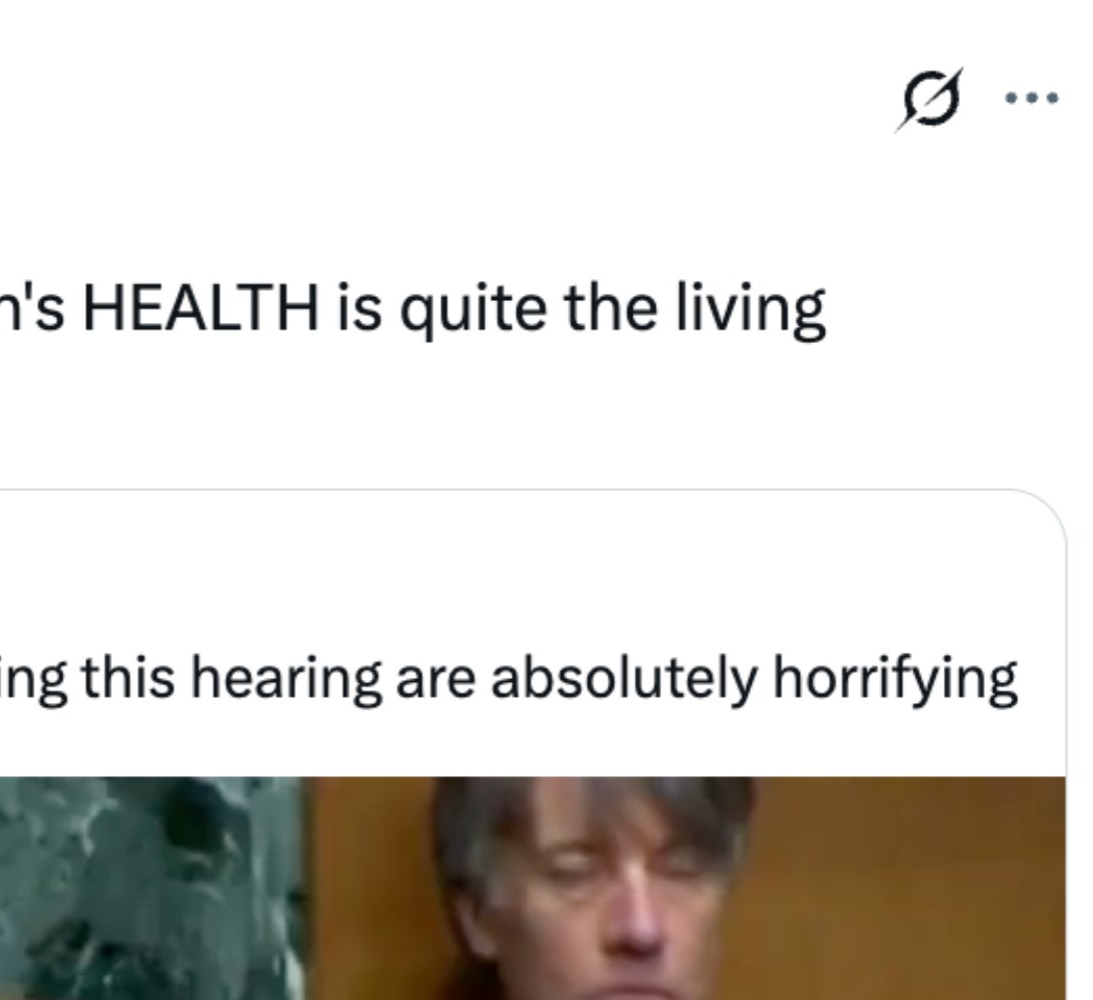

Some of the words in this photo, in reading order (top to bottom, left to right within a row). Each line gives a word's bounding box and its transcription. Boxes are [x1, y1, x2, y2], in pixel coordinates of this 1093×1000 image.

[85, 283, 317, 330] HEALTH
[338, 281, 382, 331] is
[401, 281, 547, 343] quite
[563, 280, 658, 331] the
[678, 280, 826, 343] living
[80, 653, 174, 698] this
[193, 653, 383, 710] hearing
[397, 666, 476, 698] are
[492, 653, 759, 710] absolutely
[775, 653, 1018, 710] horrifying
